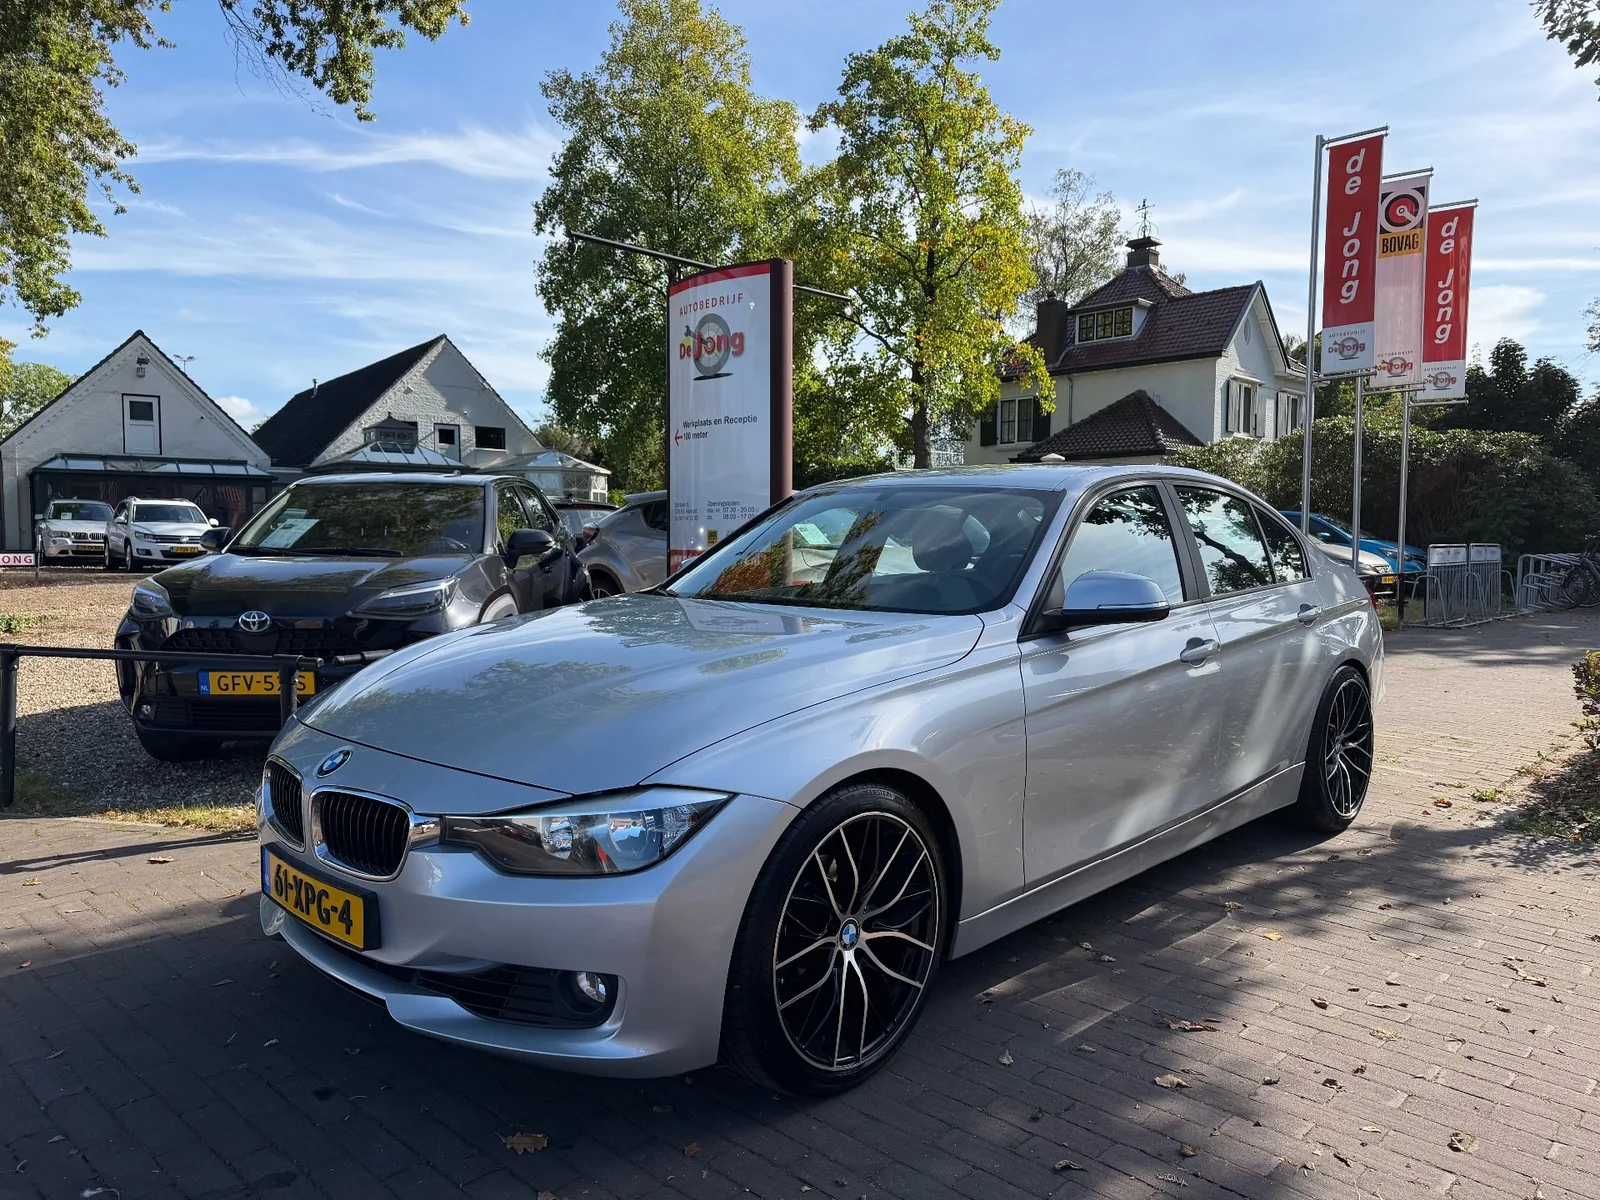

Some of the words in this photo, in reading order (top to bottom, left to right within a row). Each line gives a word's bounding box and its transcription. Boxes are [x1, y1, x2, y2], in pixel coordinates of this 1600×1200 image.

[1345, 147, 1366, 195] de
[1381, 233, 1419, 254] BOVAG
[1439, 216, 1459, 255] de
[1340, 211, 1361, 304] Jong
[680, 293, 743, 317] AUTOBEDRIJF
[1434, 268, 1454, 344] Jong
[679, 343, 691, 360] De
[692, 331, 745, 361] Jong
[1329, 329, 1366, 338] AUTOBEDRIJF
[683, 418, 712, 429] Werkplaats
[723, 414, 758, 425] Receptie
[683, 432, 691, 440] 100
[692, 431, 708, 439] meter
[2, 555, 33, 564] ONG
[274, 863, 354, 936] 61-XPG-4
